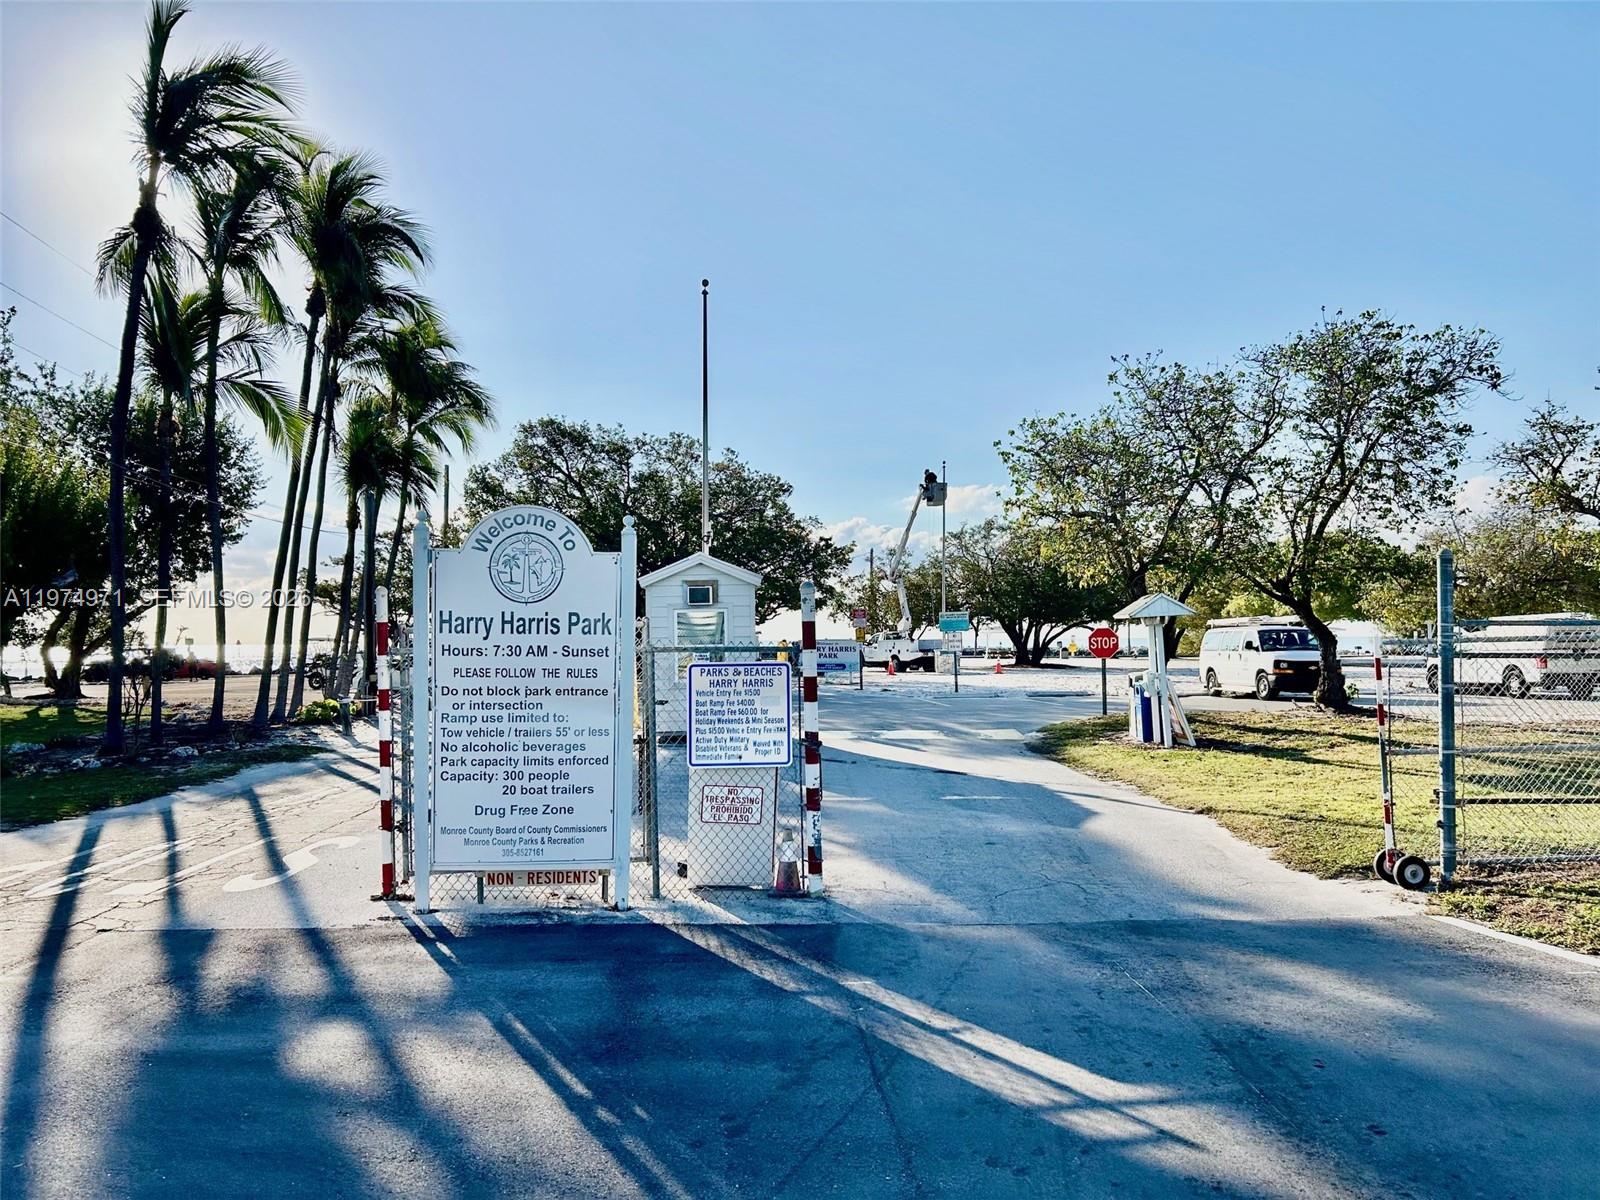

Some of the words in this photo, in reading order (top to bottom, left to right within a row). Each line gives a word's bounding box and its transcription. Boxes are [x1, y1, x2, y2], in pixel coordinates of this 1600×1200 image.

[472, 513, 556, 553] Welcome
[558, 526, 576, 551] To
[439, 610, 494, 640] Harry
[501, 611, 560, 635] Harris
[568, 612, 612, 635] Park
[1091, 637, 1117, 649] STOP
[441, 645, 488, 657] Hours:
[493, 645, 523, 657] 7:30
[526, 645, 548, 657] AM
[562, 645, 609, 658] Sunset
[453, 668, 491, 677] PLEASE
[495, 668, 535, 677] FOLLOW
[542, 668, 560, 677] THE
[567, 668, 598, 678] RULES
[700, 668, 729, 677] PARKS
[733, 668, 741, 676] &
[744, 667, 782, 676] BEACHES
[709, 680, 738, 688] HARRY
[742, 679, 774, 687] HARRIS
[441, 686, 459, 696] Do
[462, 687, 482, 696] not
[487, 686, 520, 696] block
[525, 686, 552, 699] park
[555, 687, 608, 696] entrance
[452, 702, 465, 710] or
[469, 700, 543, 710] intersection
[696, 699, 707, 707] Boat
[710, 699, 724, 708] Ramp
[695, 708, 708, 716] Boat
[710, 708, 725, 717] Ramp
[441, 713, 477, 725] Ramp
[481, 715, 504, 723] use
[507, 713, 549, 723] limited
[553, 713, 569, 723] to:
[696, 718, 716, 726] Holiday
[441, 728, 463, 738] Tow
[466, 727, 504, 738] vehicle
[507, 727, 511, 738] /
[514, 727, 552, 737] trailers
[556, 727, 571, 737] 55'
[574, 728, 586, 737] or
[588, 727, 609, 737] less
[747, 727, 761, 735] Entry
[715, 736, 727, 744] Duty
[729, 736, 749, 744] Military
[441, 742, 458, 752] No
[462, 742, 519, 752] alcoholic
[522, 741, 586, 755] beverages
[719, 744, 742, 752] Veterans
[755, 748, 773, 757] Proper
[441, 757, 467, 767] Park
[471, 756, 519, 768] capacity
[523, 756, 554, 766] limits
[558, 755, 609, 765] enforced
[441, 771, 498, 783] Capacity:
[503, 770, 524, 781] 300
[528, 770, 569, 783] people
[502, 785, 516, 795] 20
[520, 785, 547, 795] boat
[552, 784, 594, 795] trailers
[705, 796, 760, 805] TRESPASSING
[475, 805, 506, 817] Drug
[510, 805, 538, 815] Free
[542, 804, 574, 815] Zone
[711, 806, 753, 814] PROHIBIDO
[441, 827, 467, 835] Monroe
[468, 827, 494, 836] County
[496, 826, 517, 834] Board
[518, 826, 526, 834] of
[527, 825, 552, 836] County
[554, 825, 607, 834] Commissioners
[464, 838, 490, 846] Monroe
[492, 838, 517, 847] County
[519, 837, 539, 846] Parks
[541, 837, 546, 845] &
[548, 836, 584, 845] Recreation
[487, 872, 514, 885] NON
[527, 871, 597, 884] RESIDENTS
